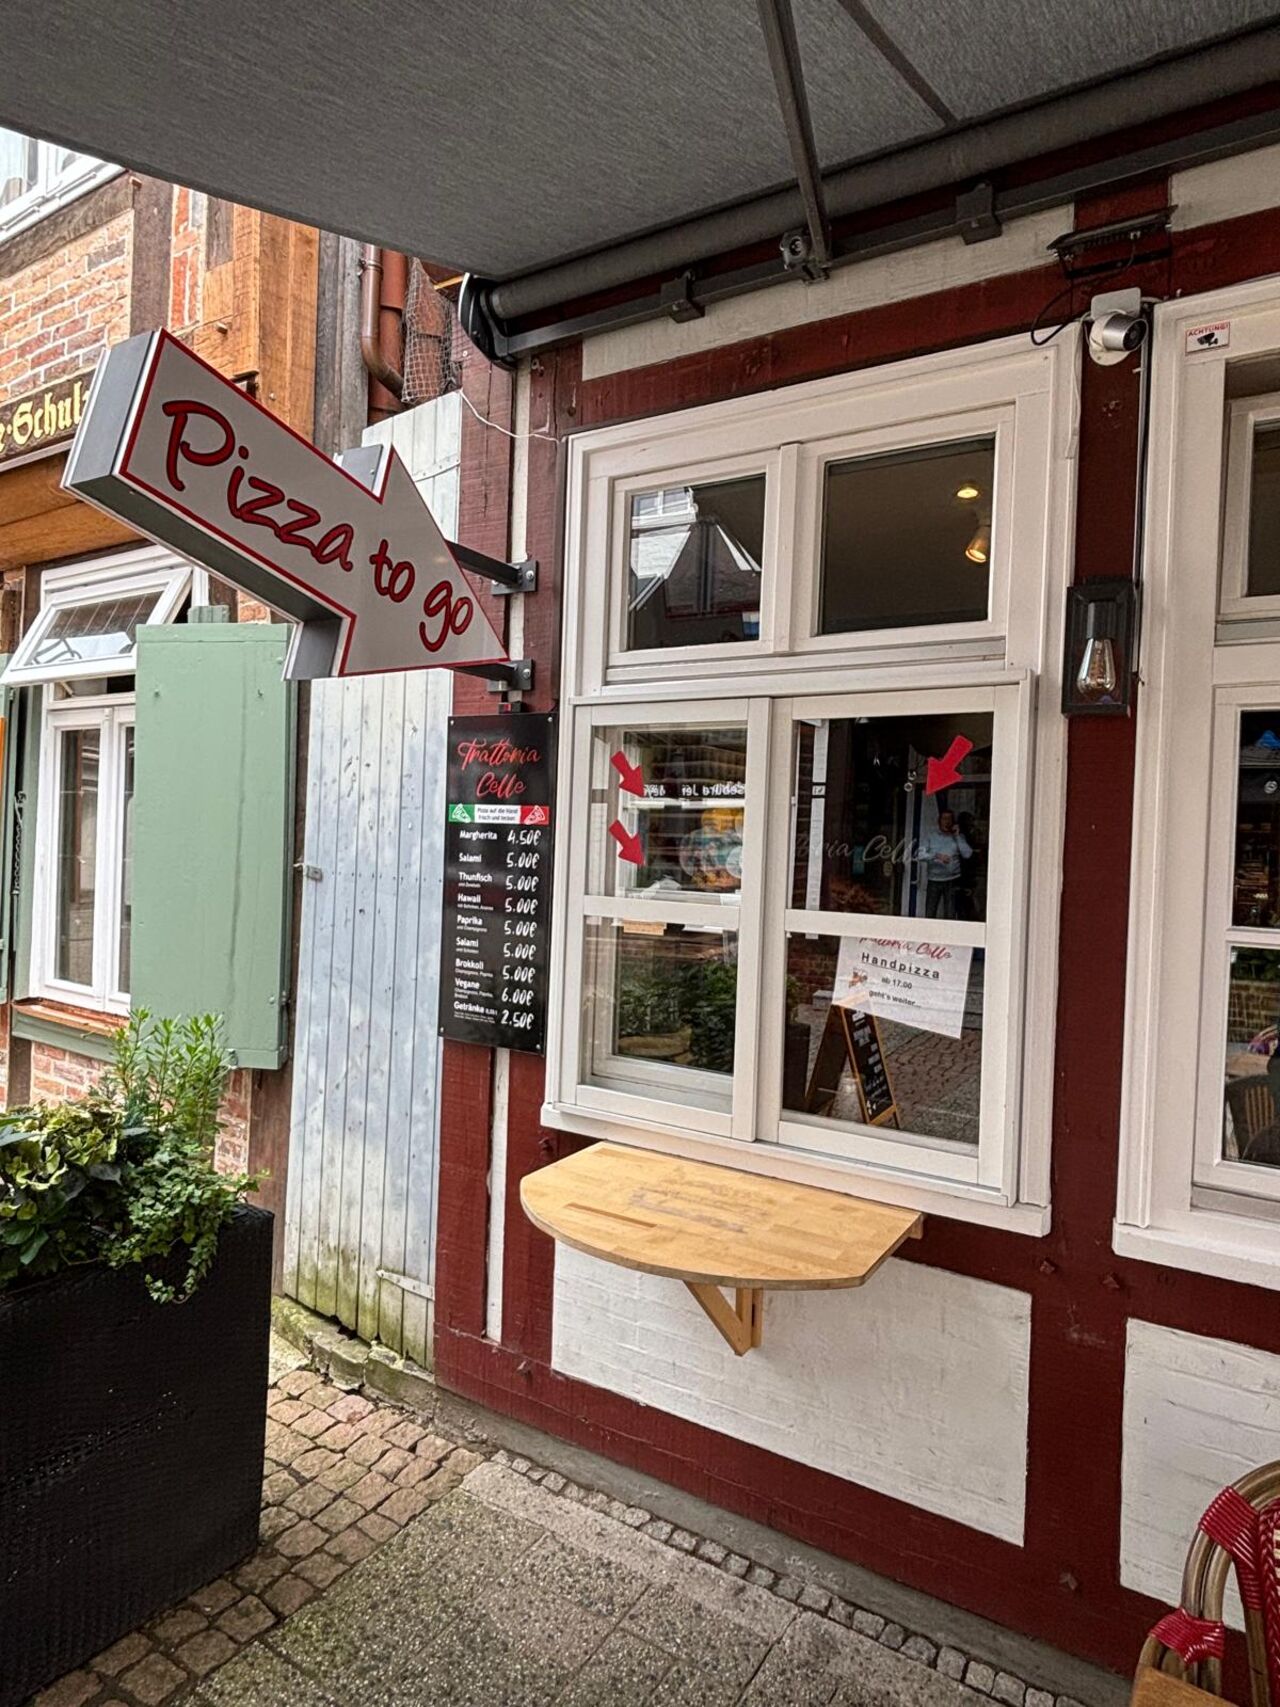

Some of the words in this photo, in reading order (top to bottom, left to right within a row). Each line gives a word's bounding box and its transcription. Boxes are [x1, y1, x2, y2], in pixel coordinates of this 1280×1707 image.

[162, 400, 353, 572] Pizza
[370, 539, 415, 603] to
[419, 580, 473, 652] go
[457, 737, 541, 771] Trattoria
[476, 771, 527, 799] Celle
[459, 829, 498, 841] Margherita
[506, 829, 542, 846] 4.50€
[458, 852, 482, 863] Salami
[506, 851, 540, 870] 5.00€
[458, 871, 493, 883] Thunfisch
[505, 875, 540, 892] 5.00€
[457, 893, 481, 903] Hawaii
[504, 897, 539, 915] 5.00€
[456, 914, 483, 926] Paprika
[503, 920, 538, 938] 5.00€
[455, 936, 479, 948] Salami
[503, 942, 537, 961] 5.00€
[455, 957, 485, 970] Brokkoli
[502, 965, 536, 984] 5.00€
[860, 951, 940, 980] Handpizza
[454, 977, 480, 990] Vegane
[501, 987, 535, 1006] 6.00€
[892, 978, 913, 990] 17.00
[453, 1000, 485, 1014] Getränke
[500, 1009, 535, 1030] 2.50€
